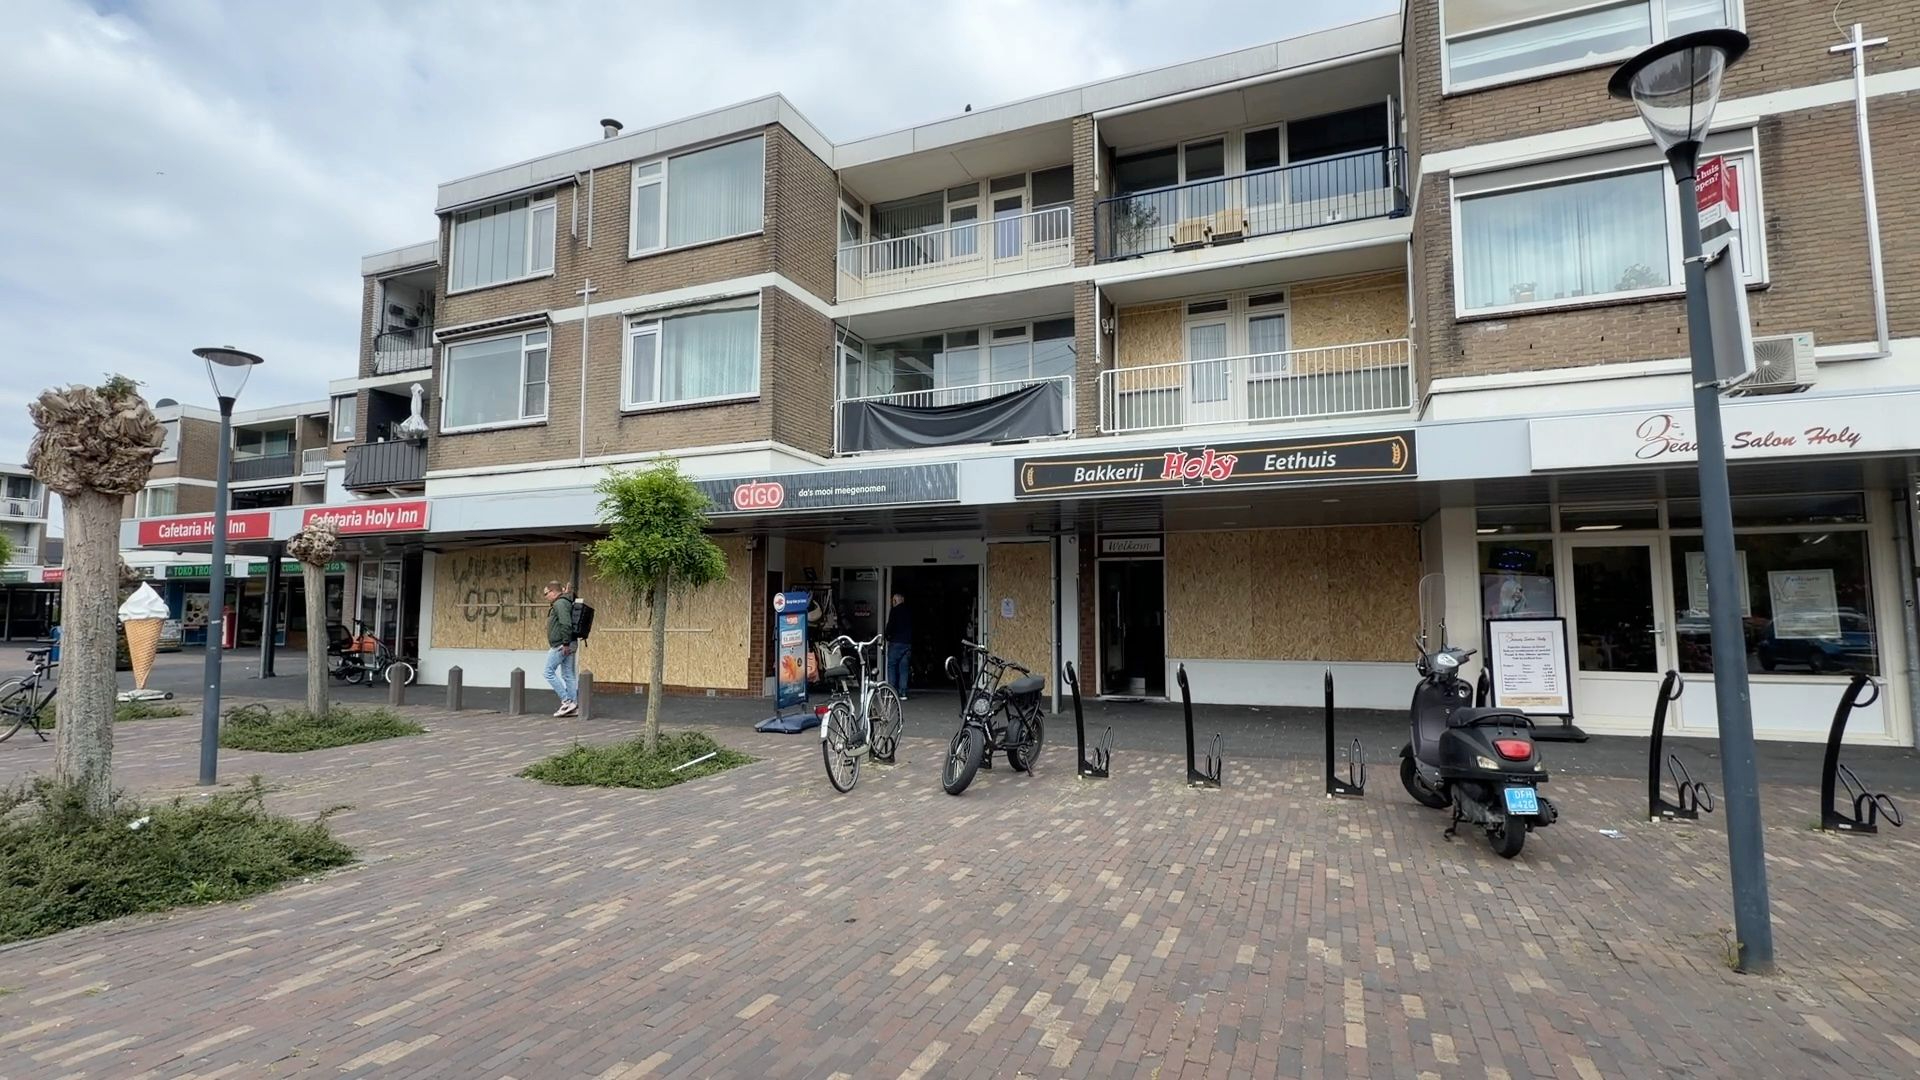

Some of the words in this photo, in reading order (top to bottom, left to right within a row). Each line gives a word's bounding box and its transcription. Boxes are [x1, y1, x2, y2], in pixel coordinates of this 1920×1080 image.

[1695, 172, 1719, 191] open?
[1731, 431, 1796, 449] Salon
[1804, 426, 1862, 448] Holy
[1074, 463, 1144, 482] Bakkerij
[1161, 449, 1238, 481] Holy
[1264, 451, 1337, 471] Eethuis
[815, 486, 833, 496] mooi
[834, 484, 886, 495] meegenomen
[365, 508, 394, 528] Holy
[397, 507, 418, 523] Inn
[159, 522, 201, 538] Cafetaria
[203, 521, 215, 536] Ho
[228, 520, 246, 534] Inn
[464, 585, 537, 632] OPEN
